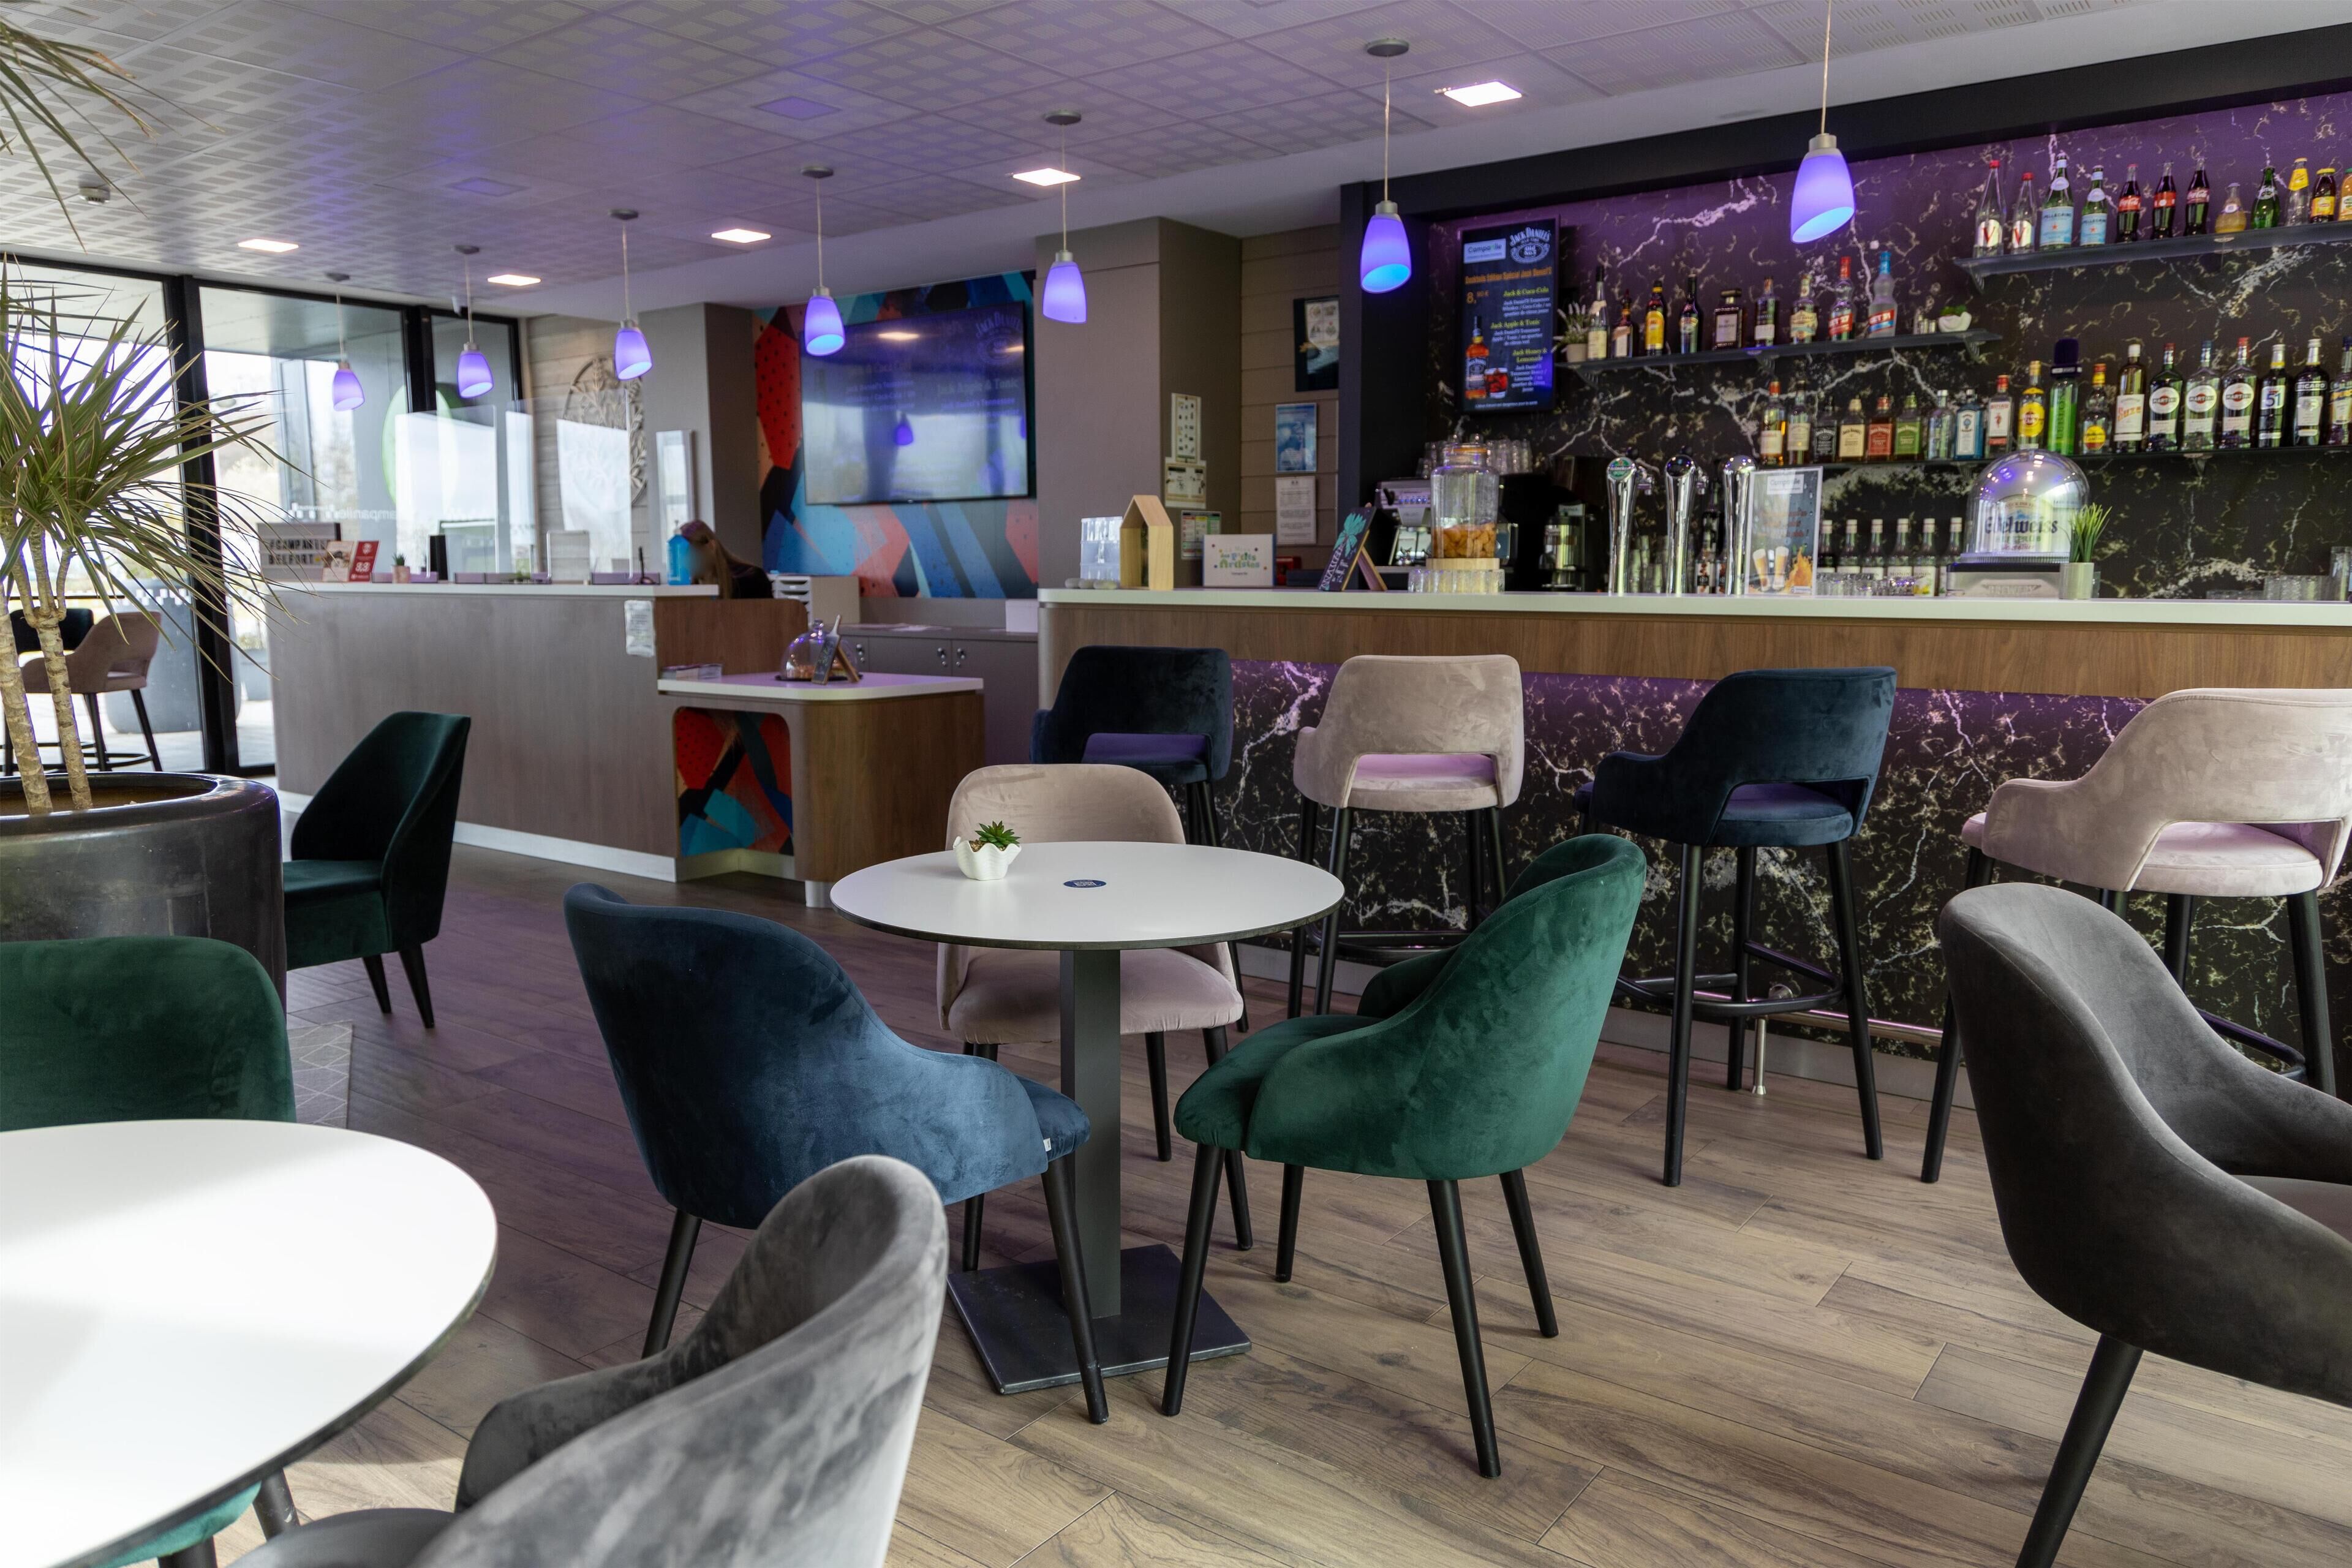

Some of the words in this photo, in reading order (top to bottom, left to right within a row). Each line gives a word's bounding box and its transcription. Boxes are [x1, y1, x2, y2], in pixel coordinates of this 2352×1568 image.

[1510, 231, 1526, 246] JACK
[1504, 320, 1519, 329] Apple
[2266, 393, 2280, 407] 51
[2117, 405, 2142, 422] Suze
[1985, 516, 2059, 534] Edelweiss
[268, 554, 314, 564] BELFORT
